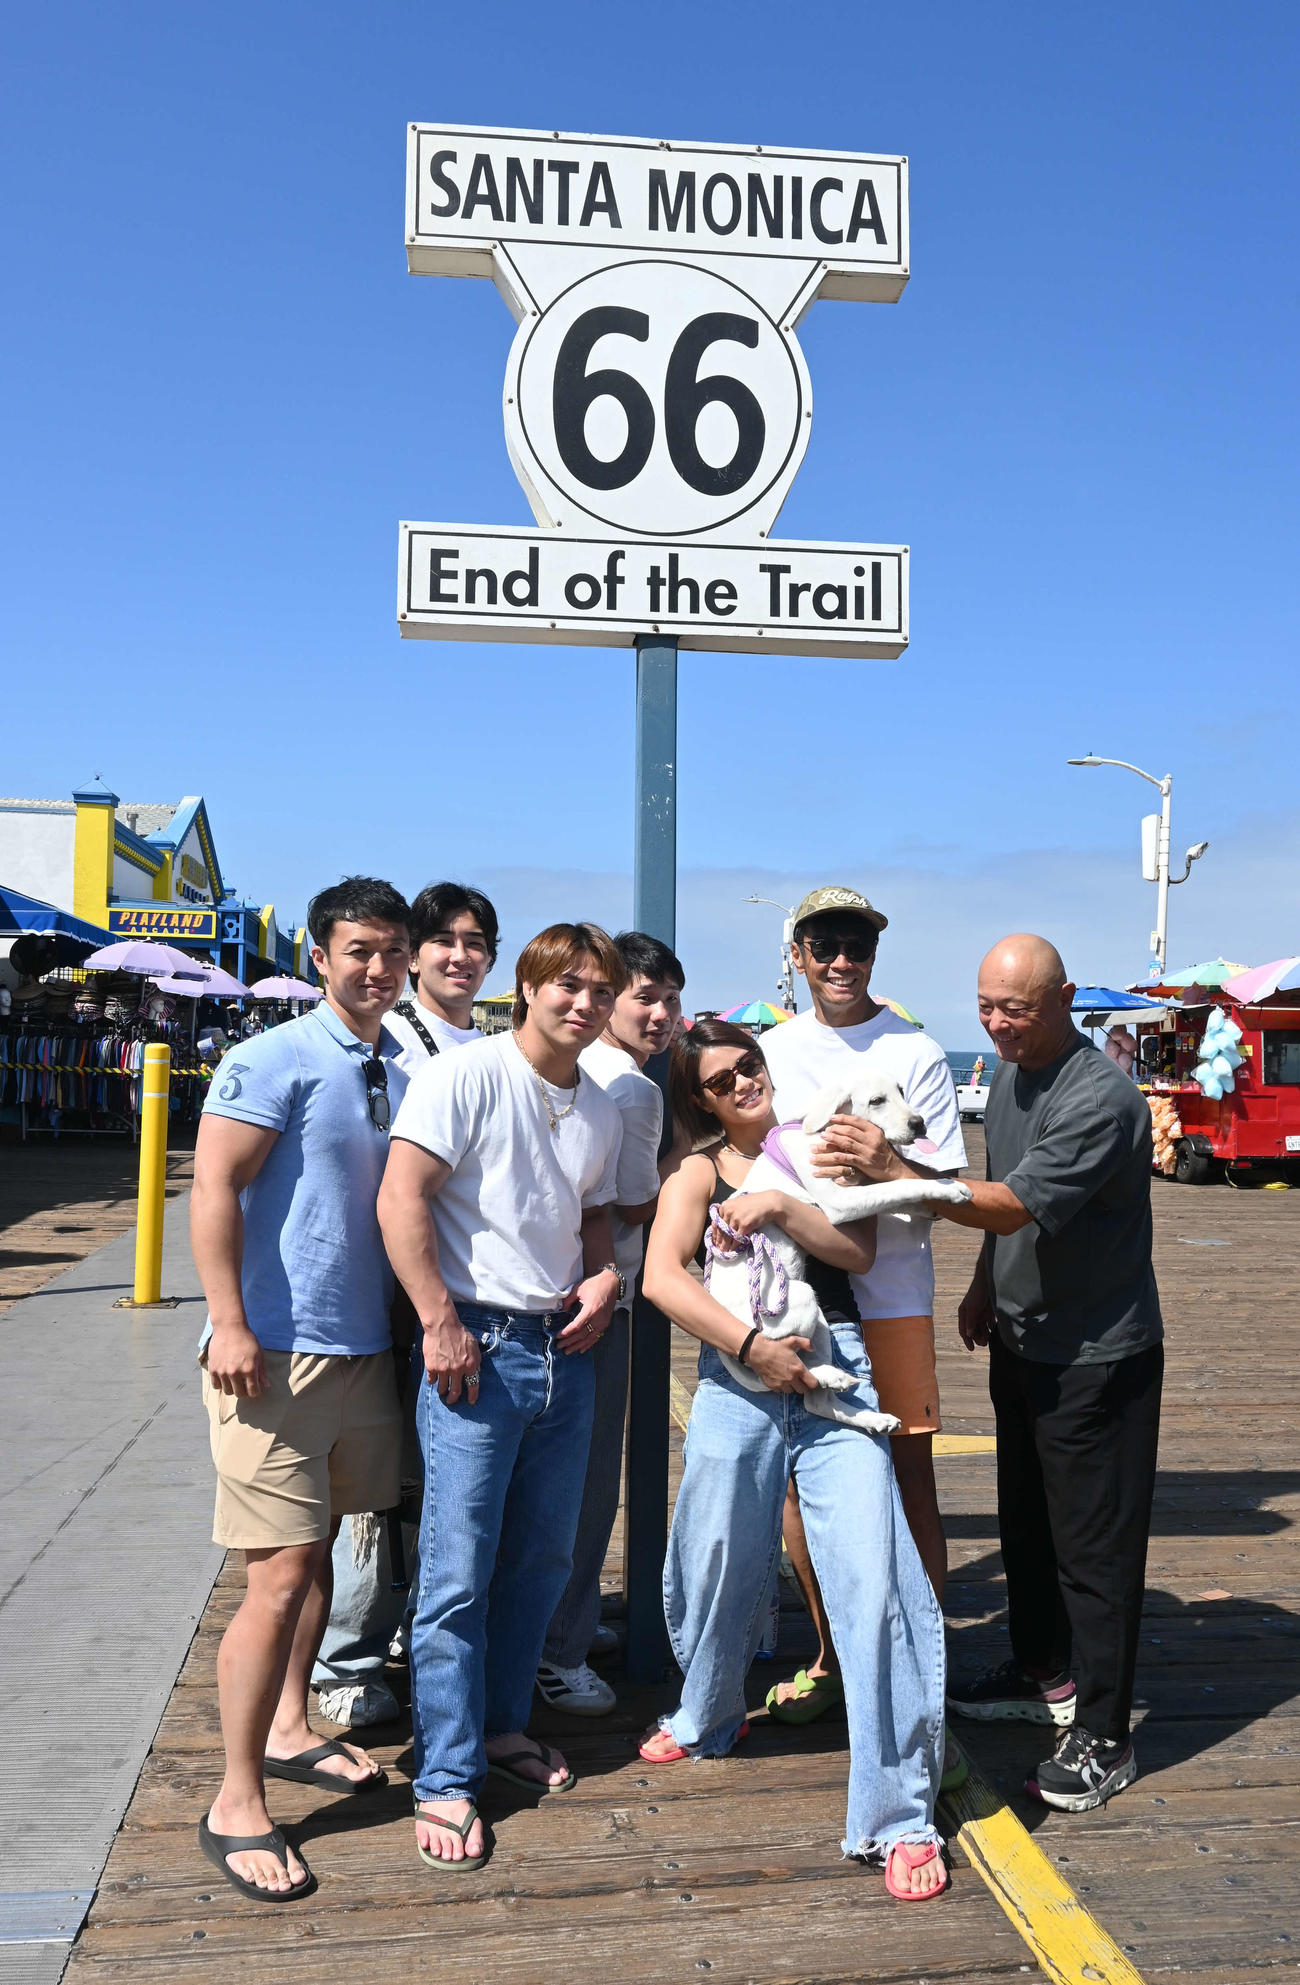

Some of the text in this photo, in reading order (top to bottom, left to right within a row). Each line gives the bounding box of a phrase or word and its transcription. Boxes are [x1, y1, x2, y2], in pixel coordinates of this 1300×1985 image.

[430, 150, 888, 245] SANTA MONICA
[552, 305, 766, 497] 66
[429, 548, 882, 621] End of the Trail
[818, 889, 869, 908] Ralph
[118, 911, 204, 928] PLAYLAND
[130, 926, 190, 935] ARCADE
[219, 1062, 250, 1102] 3
